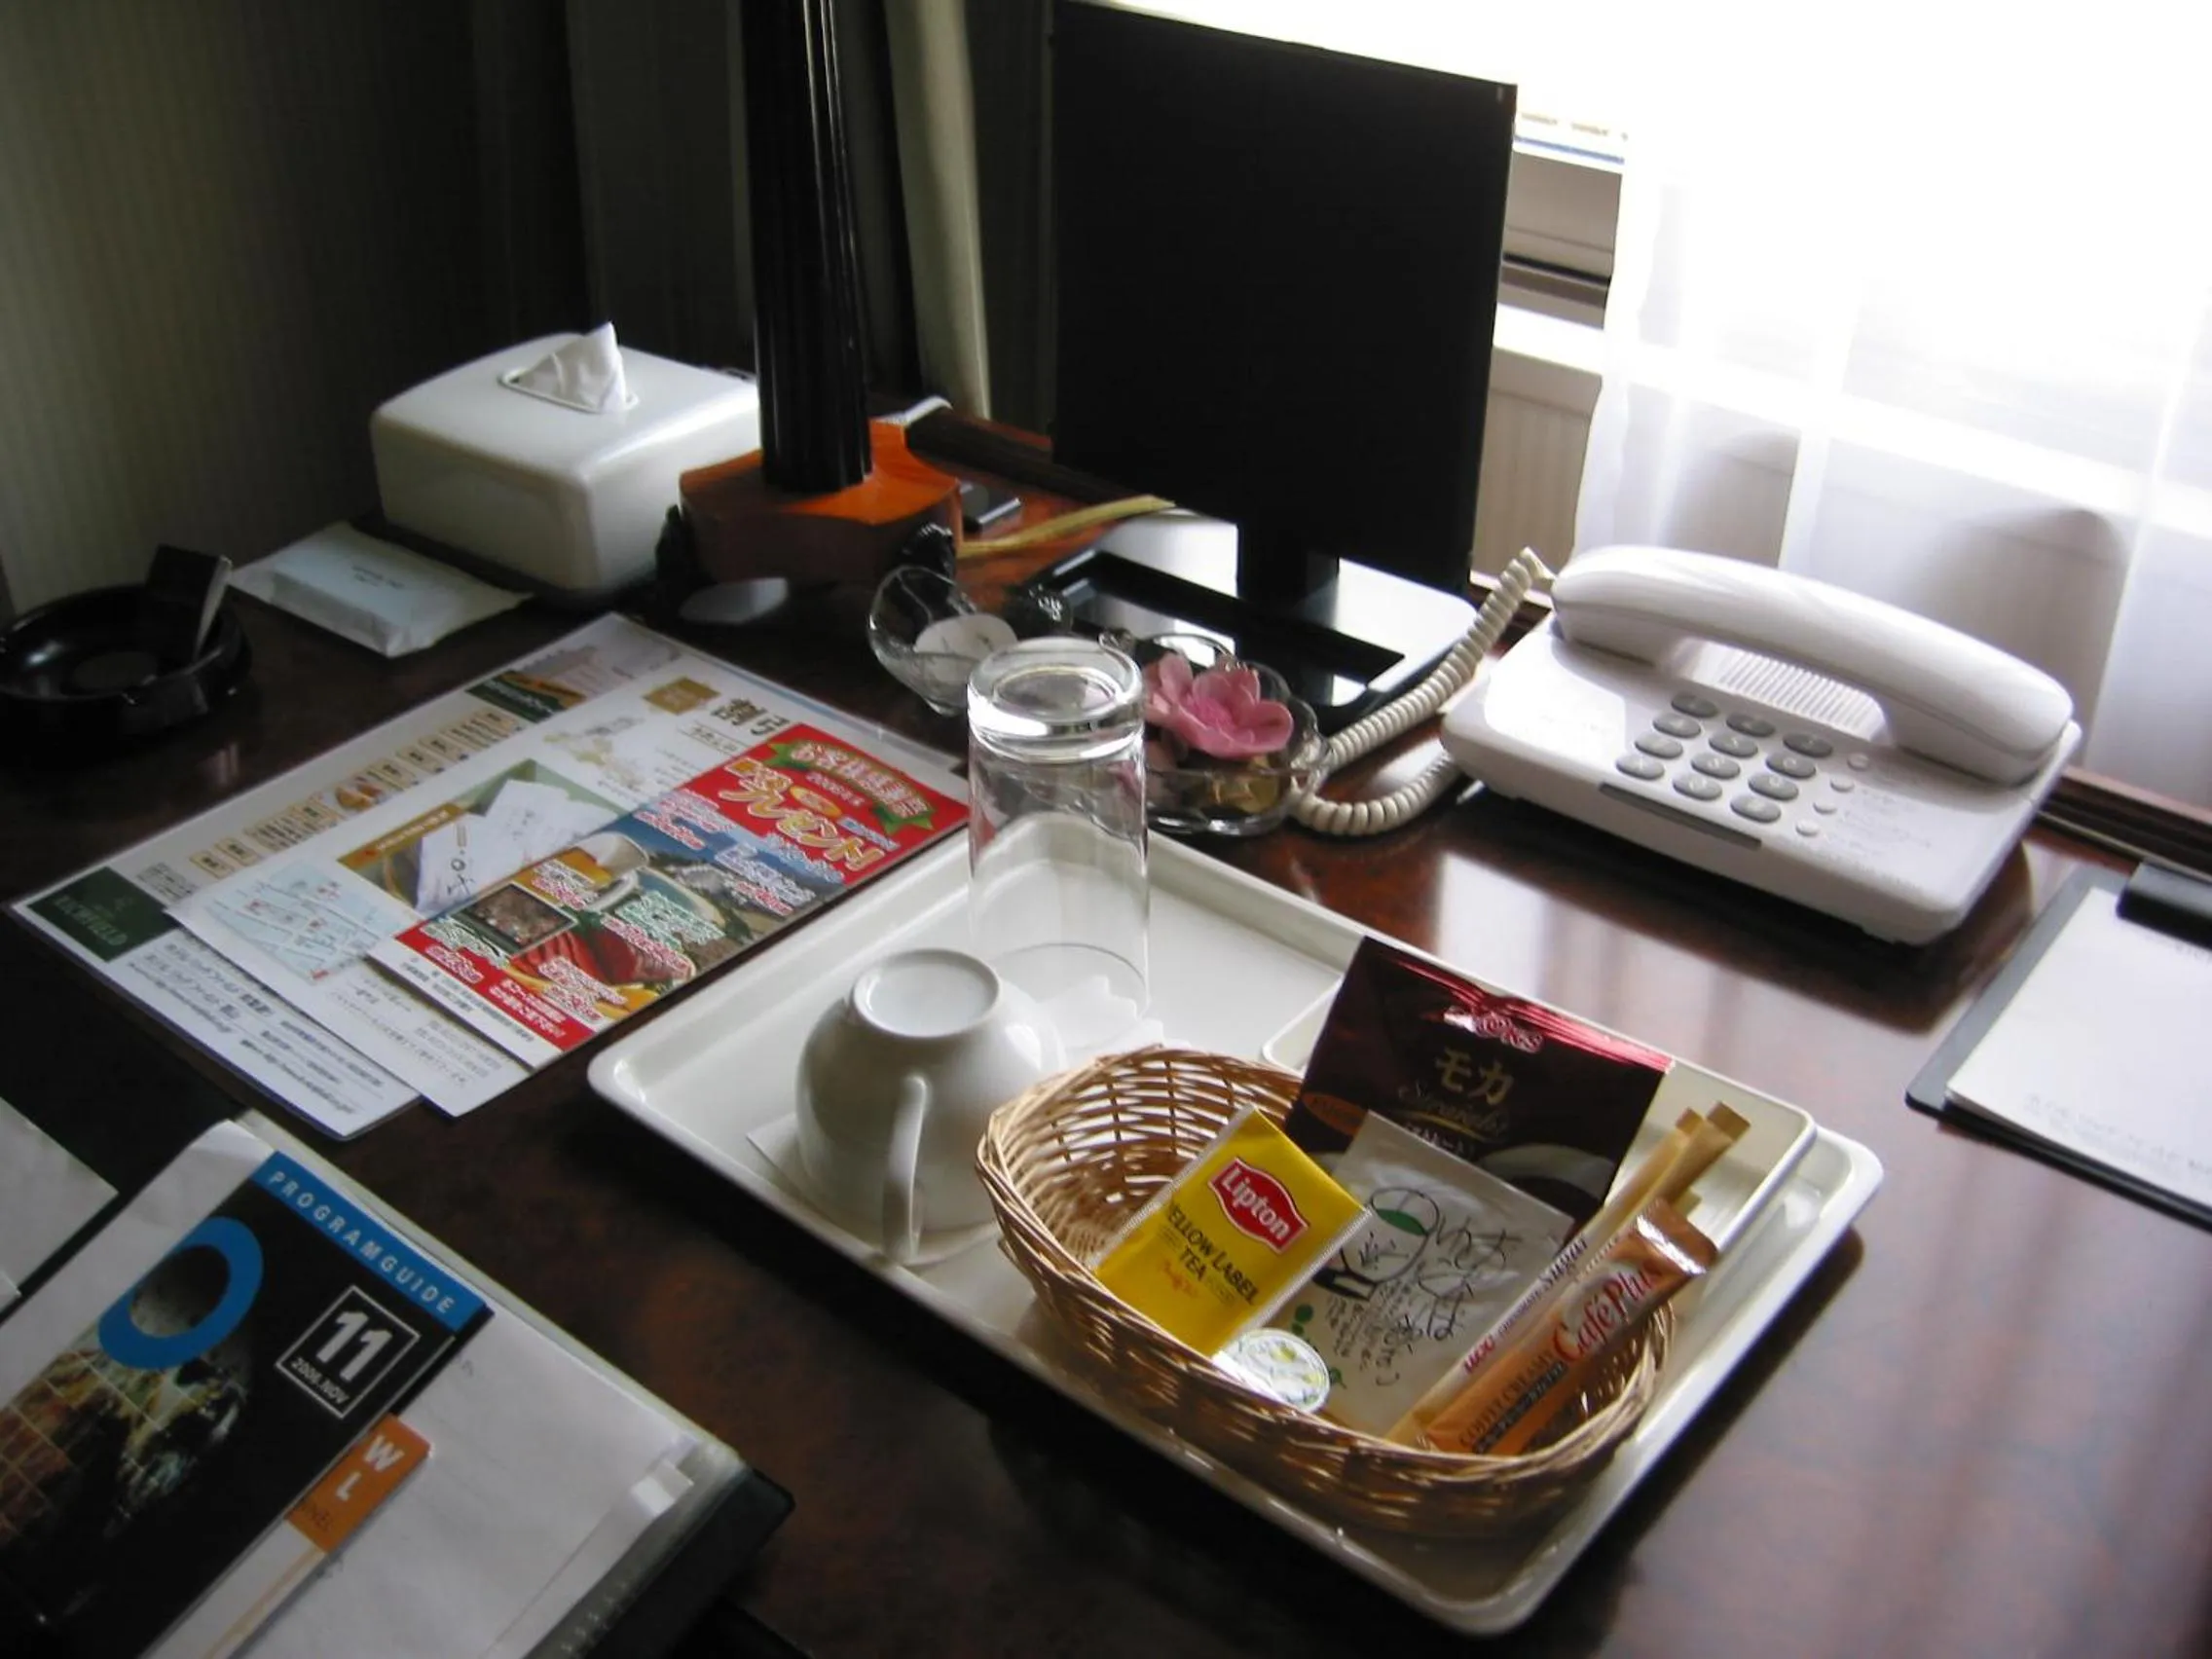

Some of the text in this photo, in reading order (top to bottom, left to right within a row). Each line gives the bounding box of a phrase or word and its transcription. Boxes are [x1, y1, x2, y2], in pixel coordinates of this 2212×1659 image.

[1433, 1046, 1514, 1105] モカ
[1169, 1200, 1217, 1258] ELLOW
[1220, 1166, 1291, 1241] Lipton
[1178, 1243, 1208, 1282] TEA
[315, 1310, 393, 1382] 11
